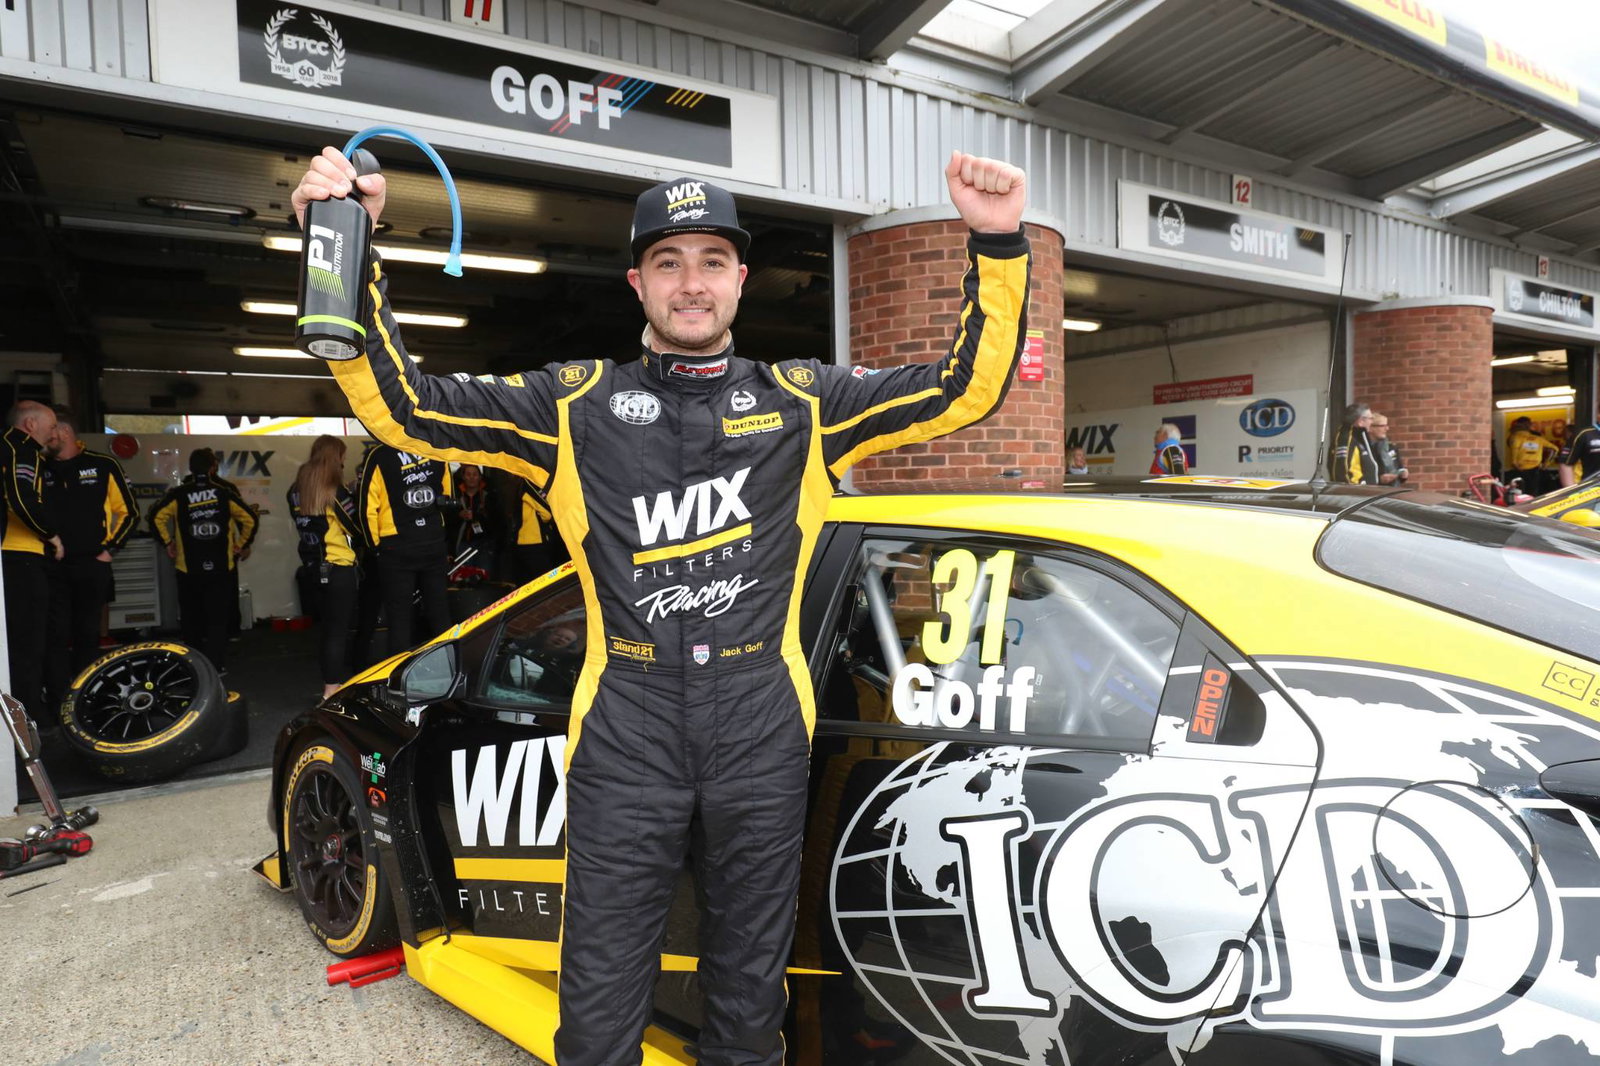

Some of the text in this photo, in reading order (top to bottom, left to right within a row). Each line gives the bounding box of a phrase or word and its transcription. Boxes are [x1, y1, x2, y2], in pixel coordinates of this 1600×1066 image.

[282, 33, 330, 57] BTCC
[298, 66, 315, 78] 60
[321, 73, 339, 82] 2018
[1494, 40, 1571, 93] PIRELLI
[490, 65, 623, 130] GOFF
[665, 182, 706, 204] WIX
[1235, 180, 1250, 203] 12
[307, 224, 335, 273] P1
[333, 231, 344, 277] NUTRITION
[1230, 222, 1288, 261] SMITH
[1539, 291, 1581, 318] CHILTON
[616, 394, 660, 418] ICD
[1245, 406, 1293, 430] ICD
[731, 416, 779, 430] DUNLOP
[1258, 446, 1295, 454] PRIORITY
[79, 468, 97, 477] WIX
[187, 488, 218, 504] WIX
[407, 489, 434, 504] ICD
[632, 466, 752, 546] WIX
[193, 523, 220, 537] ICD
[634, 540, 752, 582] FILTERS
[635, 573, 759, 624] Racing
[921, 548, 1016, 666] 31
[720, 647, 741, 657] Jack
[745, 641, 764, 653] Goff
[892, 662, 1036, 733] Goff
[1192, 668, 1228, 736] OPEN
[458, 888, 565, 916] FILTE
[940, 777, 1560, 1031] ICD
